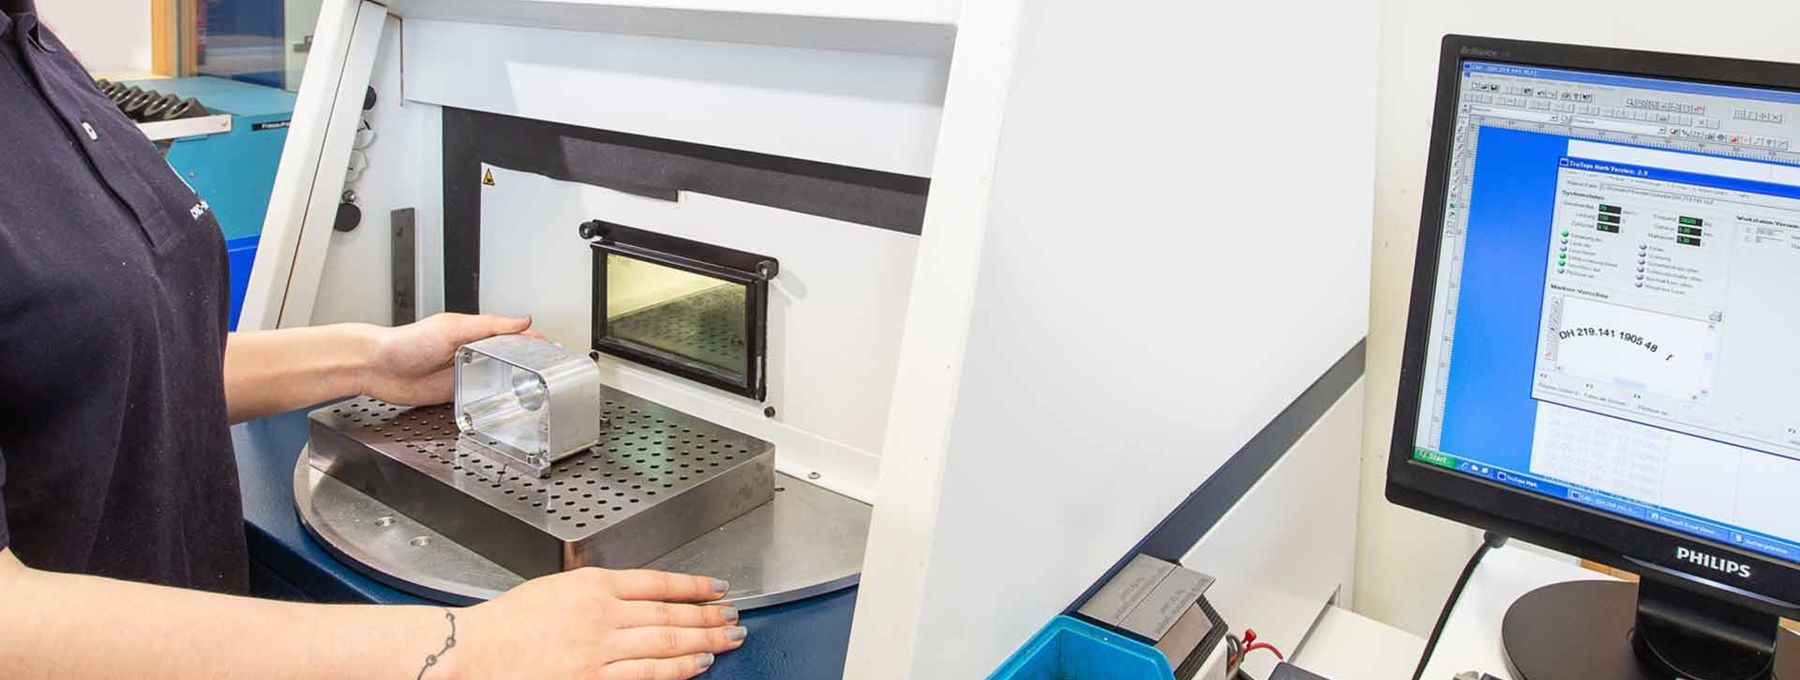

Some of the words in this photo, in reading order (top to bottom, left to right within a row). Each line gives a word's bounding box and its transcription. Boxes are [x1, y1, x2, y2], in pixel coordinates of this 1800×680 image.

[1559, 329, 1575, 340] DH
[1576, 327, 1615, 337] 219.141
[1620, 331, 1644, 346] 1905
[1644, 341, 1659, 353] 48
[1676, 546, 1751, 578] PHILIPS
